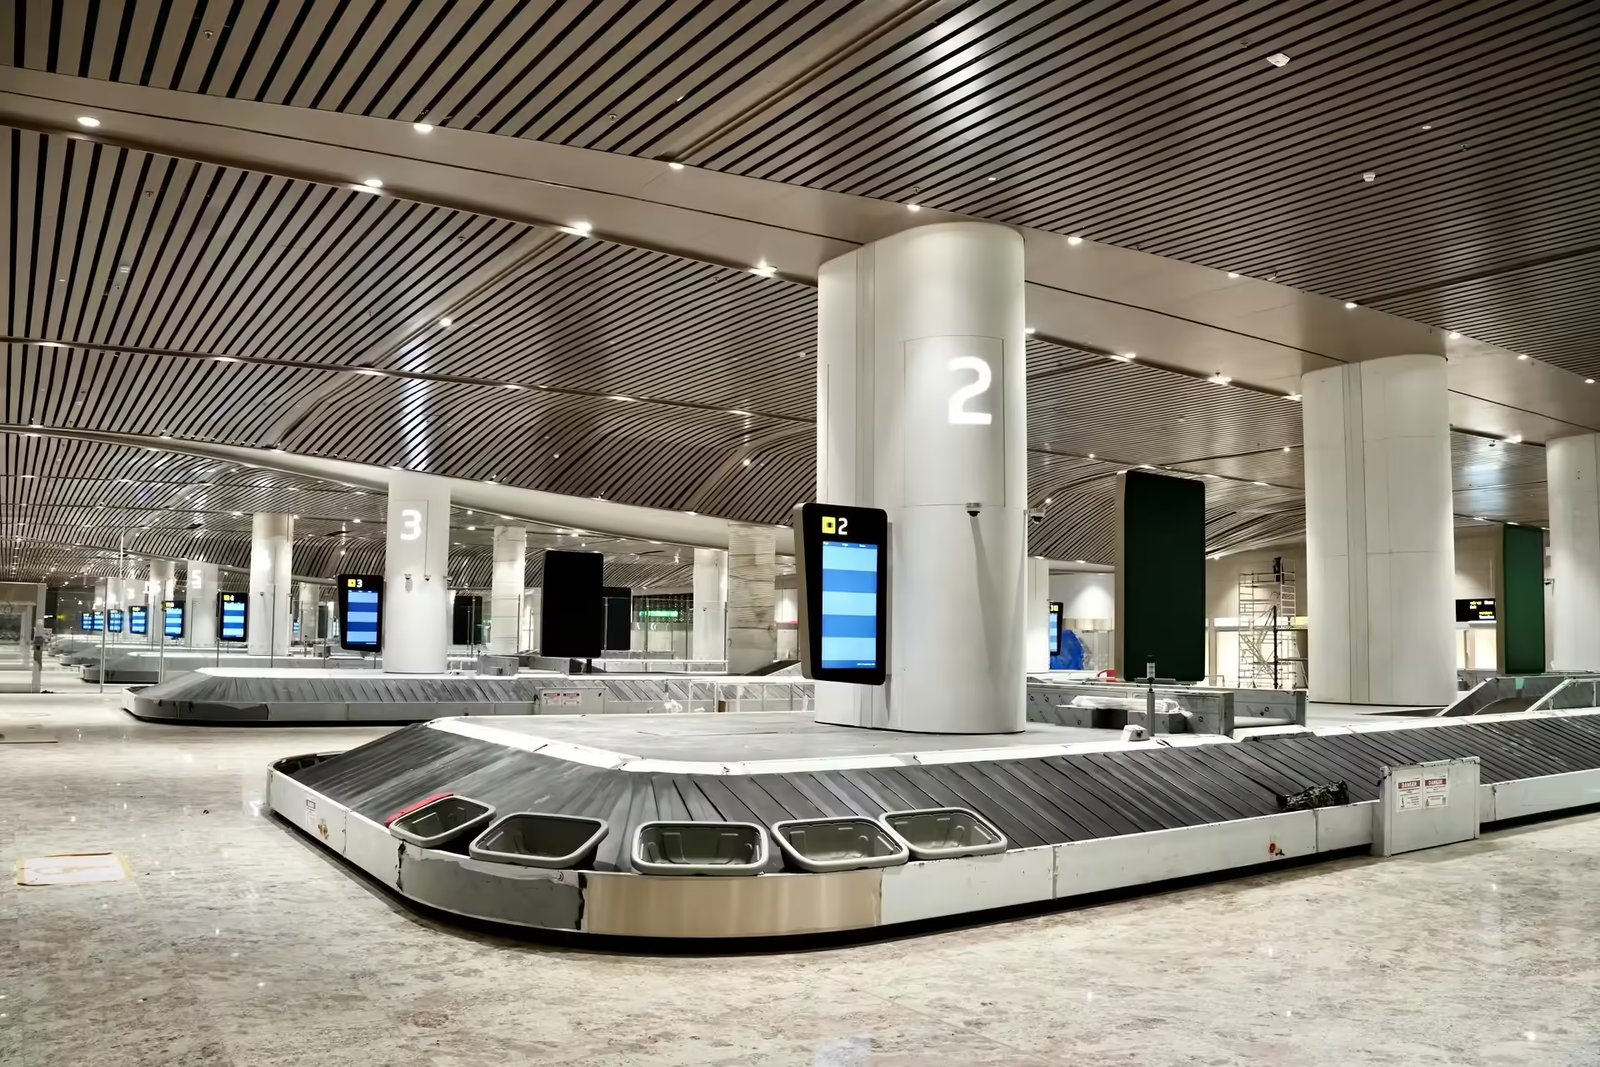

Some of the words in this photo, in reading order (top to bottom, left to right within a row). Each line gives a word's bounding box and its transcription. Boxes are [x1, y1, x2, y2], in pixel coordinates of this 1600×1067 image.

[948, 356, 992, 424] 2
[401, 509, 422, 540] 3
[838, 517, 848, 535] 2
[192, 570, 202, 589] 5
[356, 579, 363, 588] 3
